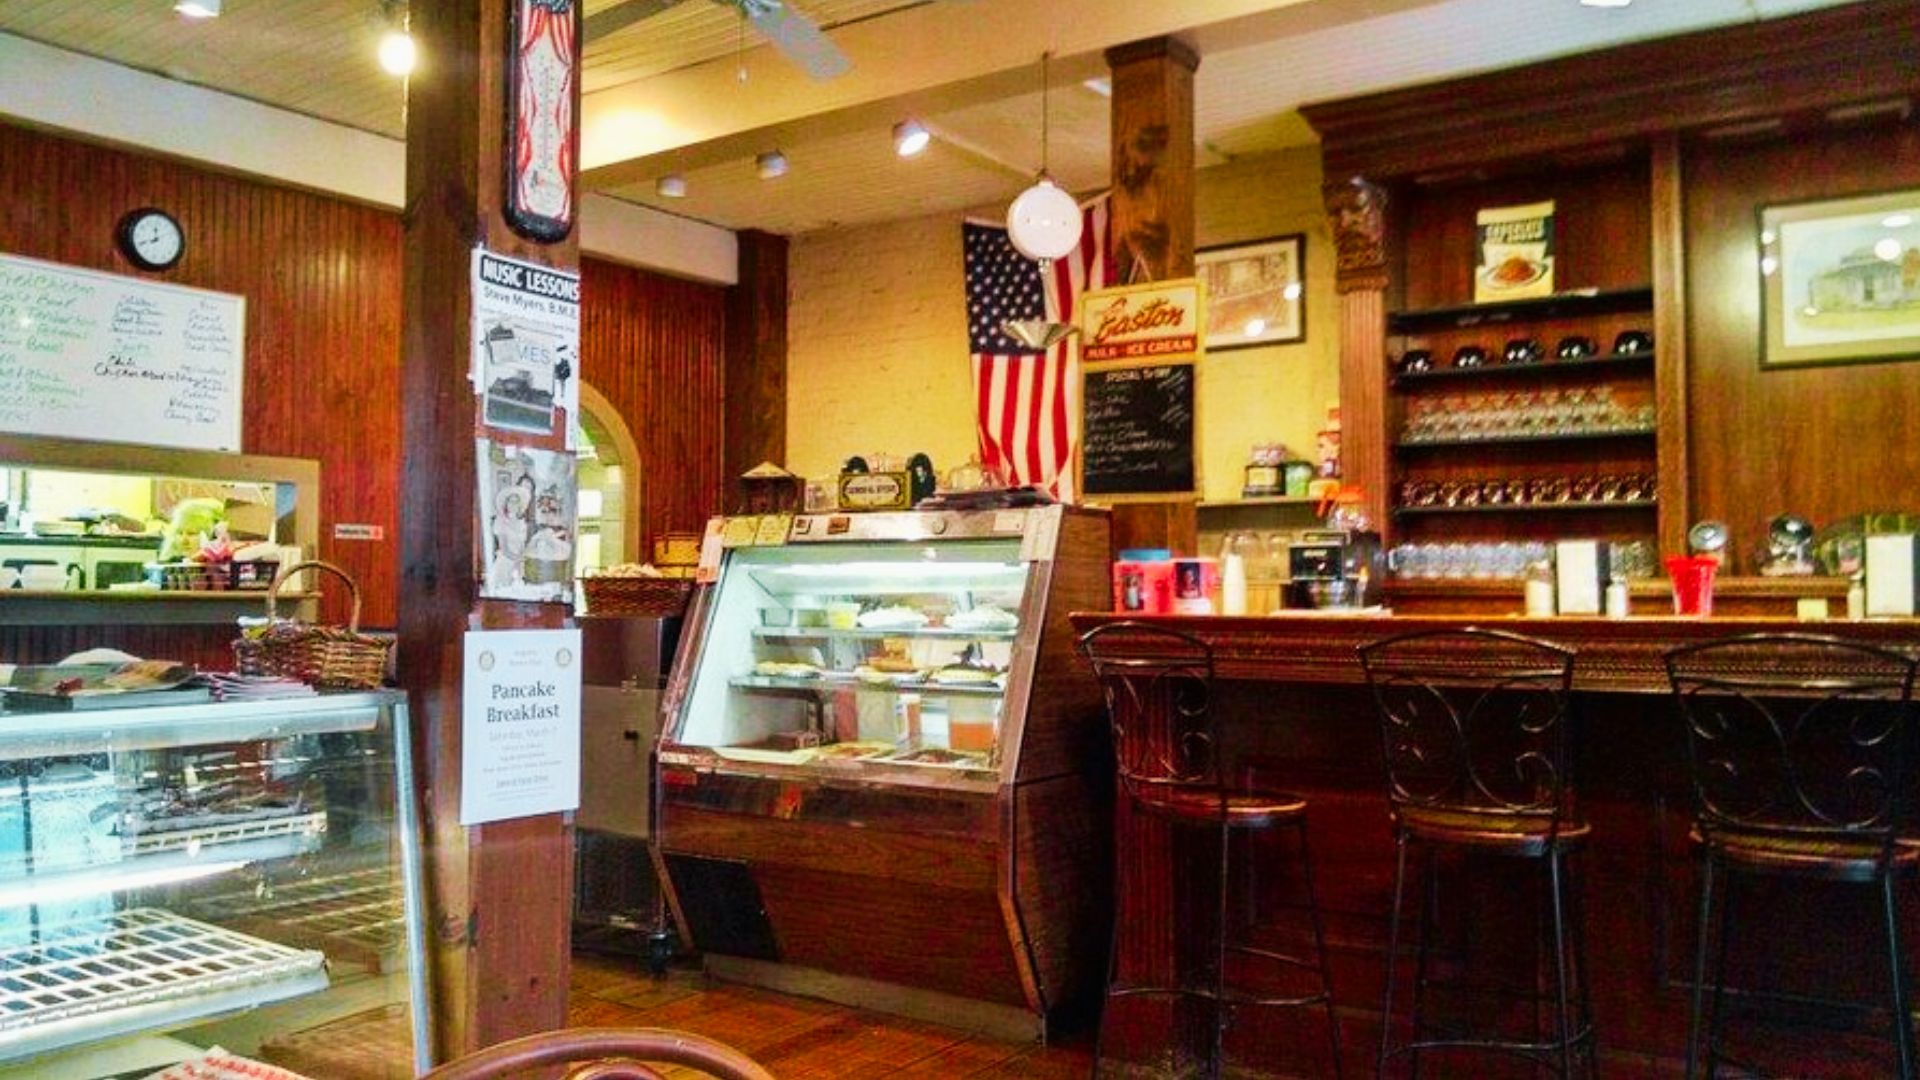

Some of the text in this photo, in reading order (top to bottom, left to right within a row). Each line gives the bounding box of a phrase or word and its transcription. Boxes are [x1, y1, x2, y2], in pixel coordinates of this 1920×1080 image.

[482, 259, 580, 301] MUSIC LESSONS
[1125, 342, 1147, 356] ICE
[1147, 338, 1194, 354] CREAM
[491, 681, 556, 699] Pancake
[487, 704, 560, 723] Breakfast
